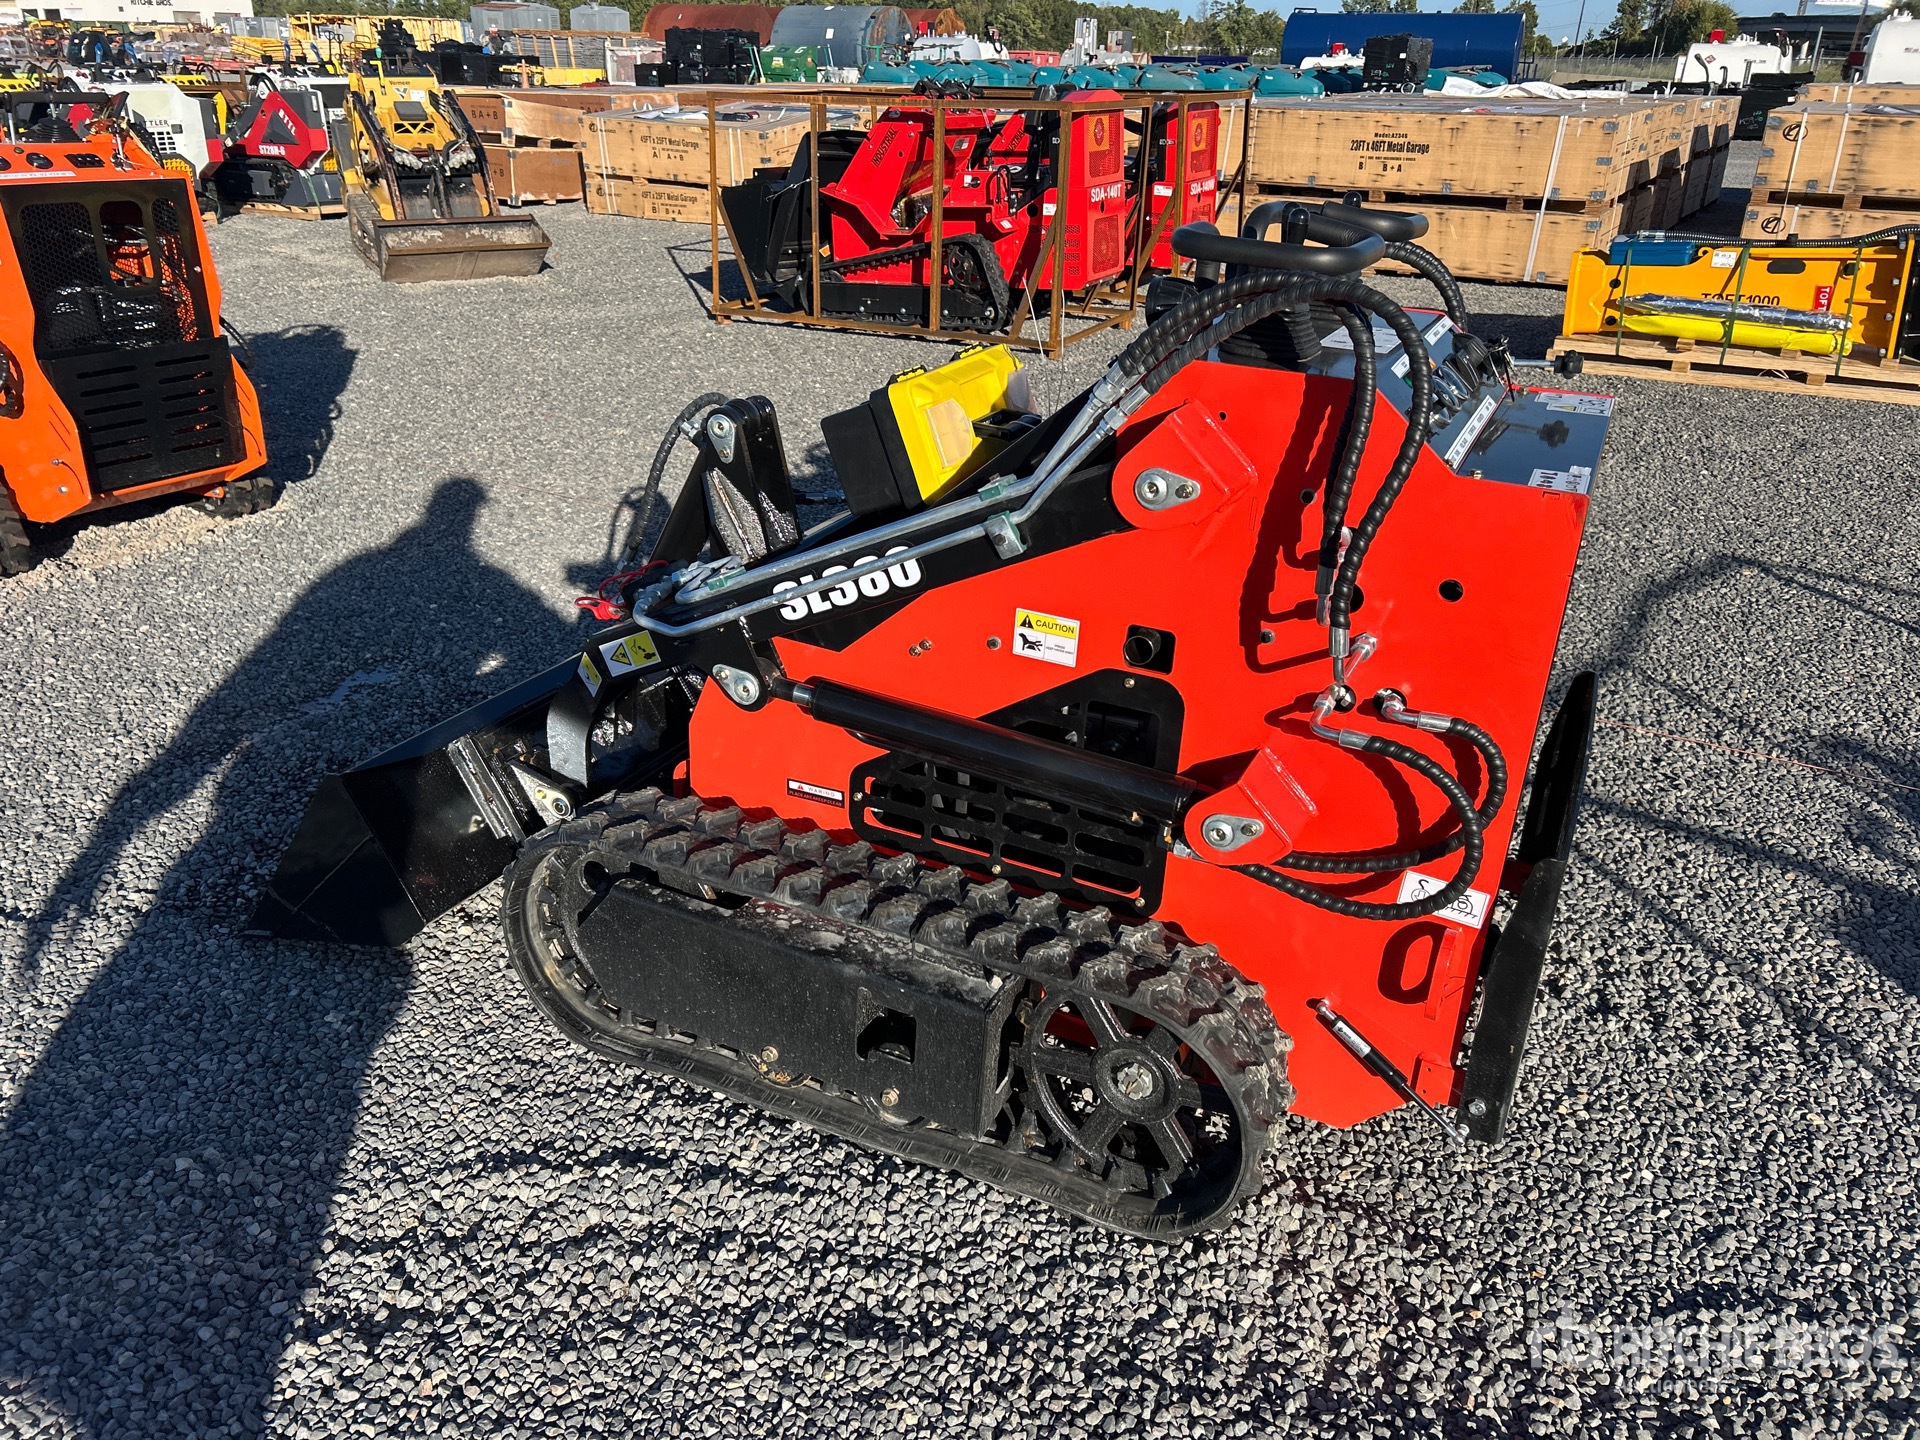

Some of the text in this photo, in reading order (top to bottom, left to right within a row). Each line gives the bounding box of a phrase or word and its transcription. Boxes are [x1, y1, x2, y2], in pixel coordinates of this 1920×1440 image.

[668, 138, 680, 147] Metal
[681, 138, 699, 150] Garage
[871, 126, 898, 168] INDUSTRIAL
[1350, 140, 1430, 155] 23FT x 46FT Metal Garage
[667, 192, 679, 201] Metal
[680, 193, 698, 204] Garage
[1090, 184, 1122, 203] SDA-140T
[1817, 286, 1831, 312] TOFT
[1035, 619, 1075, 634] CAUTION
